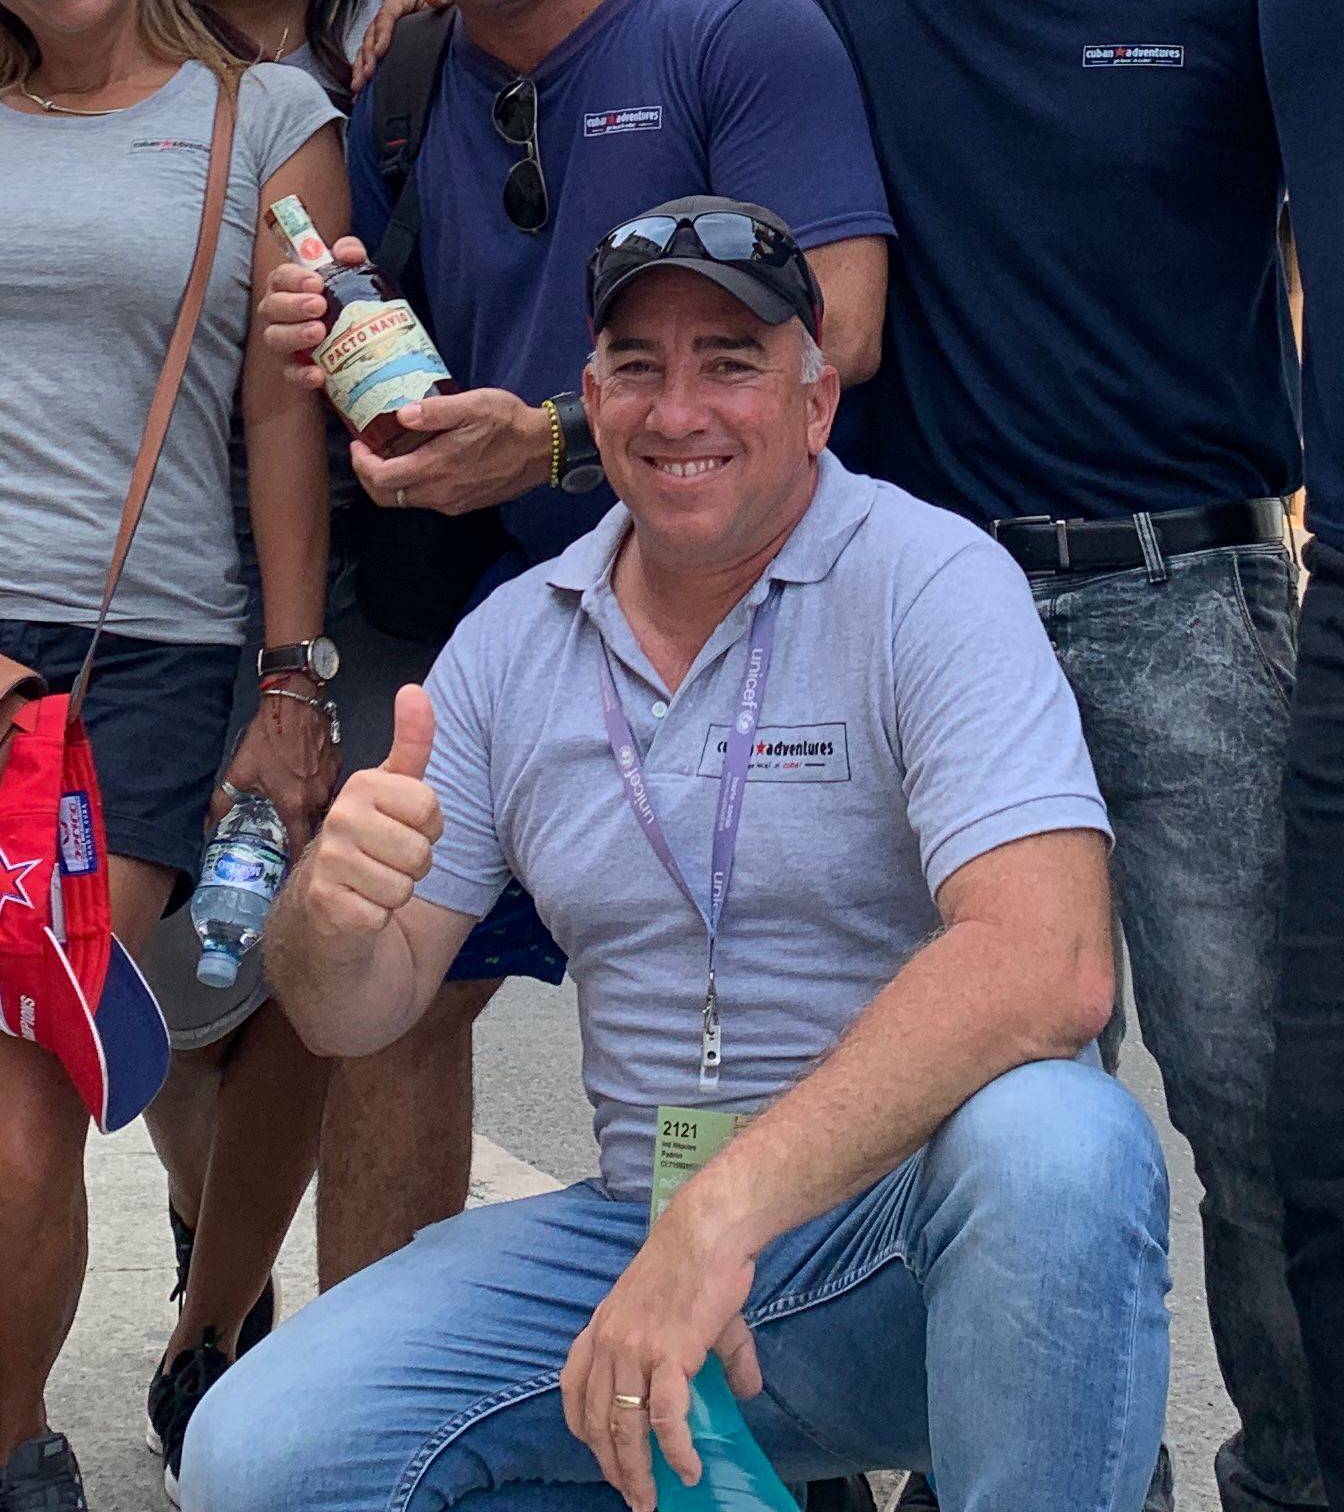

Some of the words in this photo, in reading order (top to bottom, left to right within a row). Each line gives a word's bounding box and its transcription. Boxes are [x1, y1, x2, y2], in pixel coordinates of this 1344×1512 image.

[1085, 48, 1115, 58] cuban
[1125, 47, 1181, 58] adventures
[616, 110, 659, 124] adventures
[327, 330, 367, 366] PACTO
[742, 647, 764, 710] unicef
[765, 740, 834, 756] adventures
[623, 766, 655, 826] unicef
[662, 1120, 698, 1139] 2121
